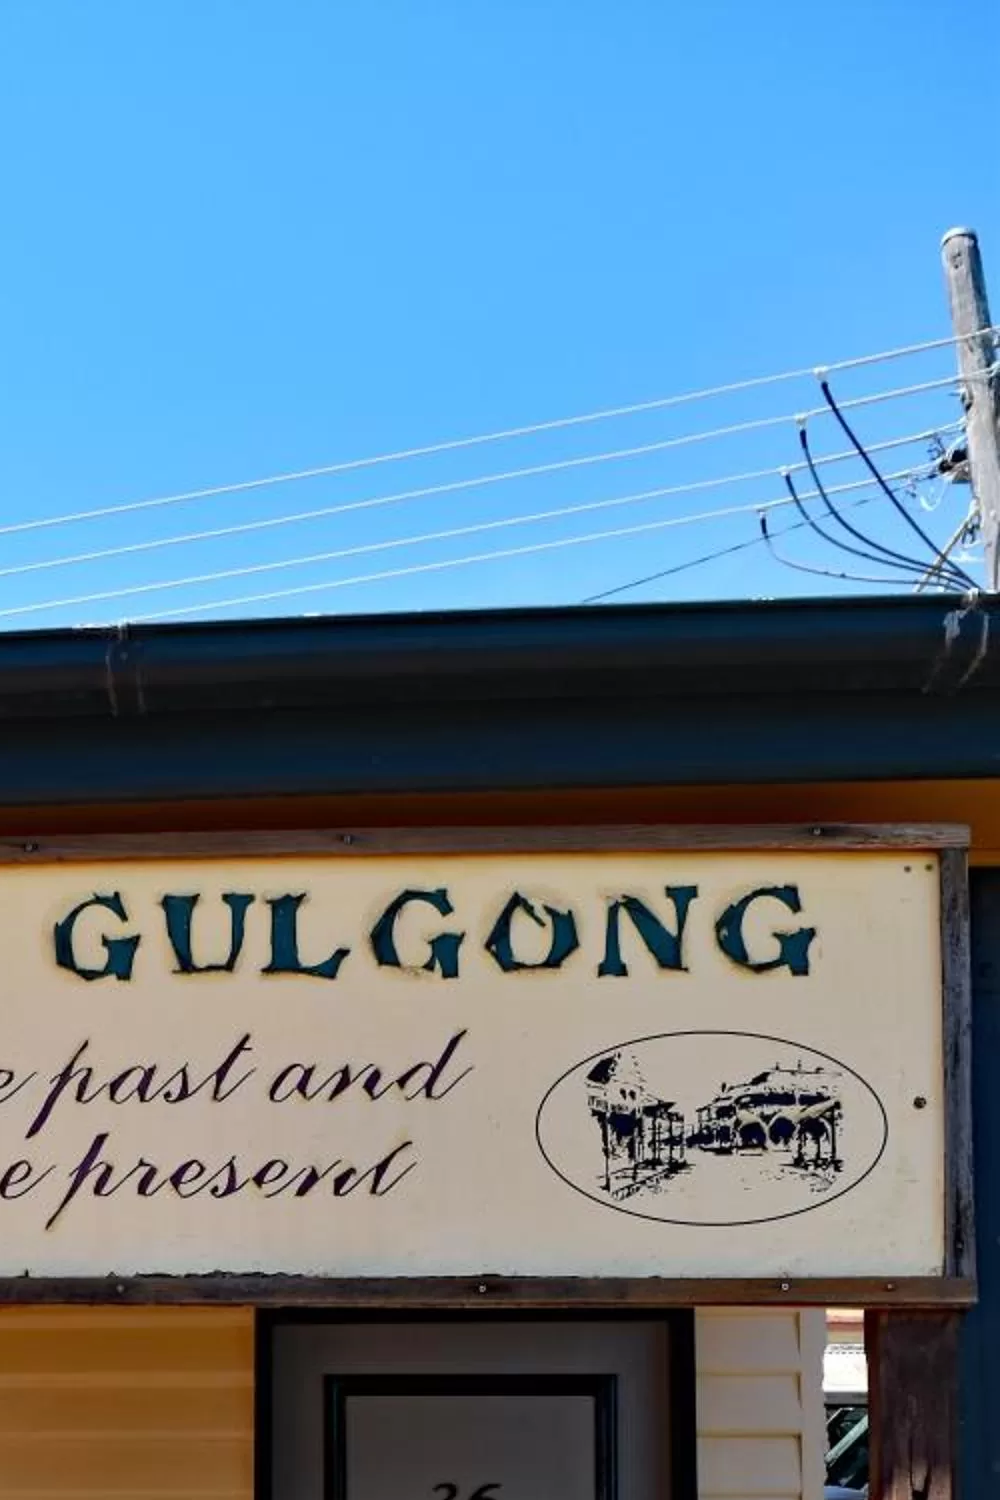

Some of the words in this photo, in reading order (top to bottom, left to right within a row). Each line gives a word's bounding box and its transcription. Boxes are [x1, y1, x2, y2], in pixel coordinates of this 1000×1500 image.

[51, 883, 818, 983] GULGONG
[27, 1030, 257, 1140] past
[268, 1028, 474, 1104] and
